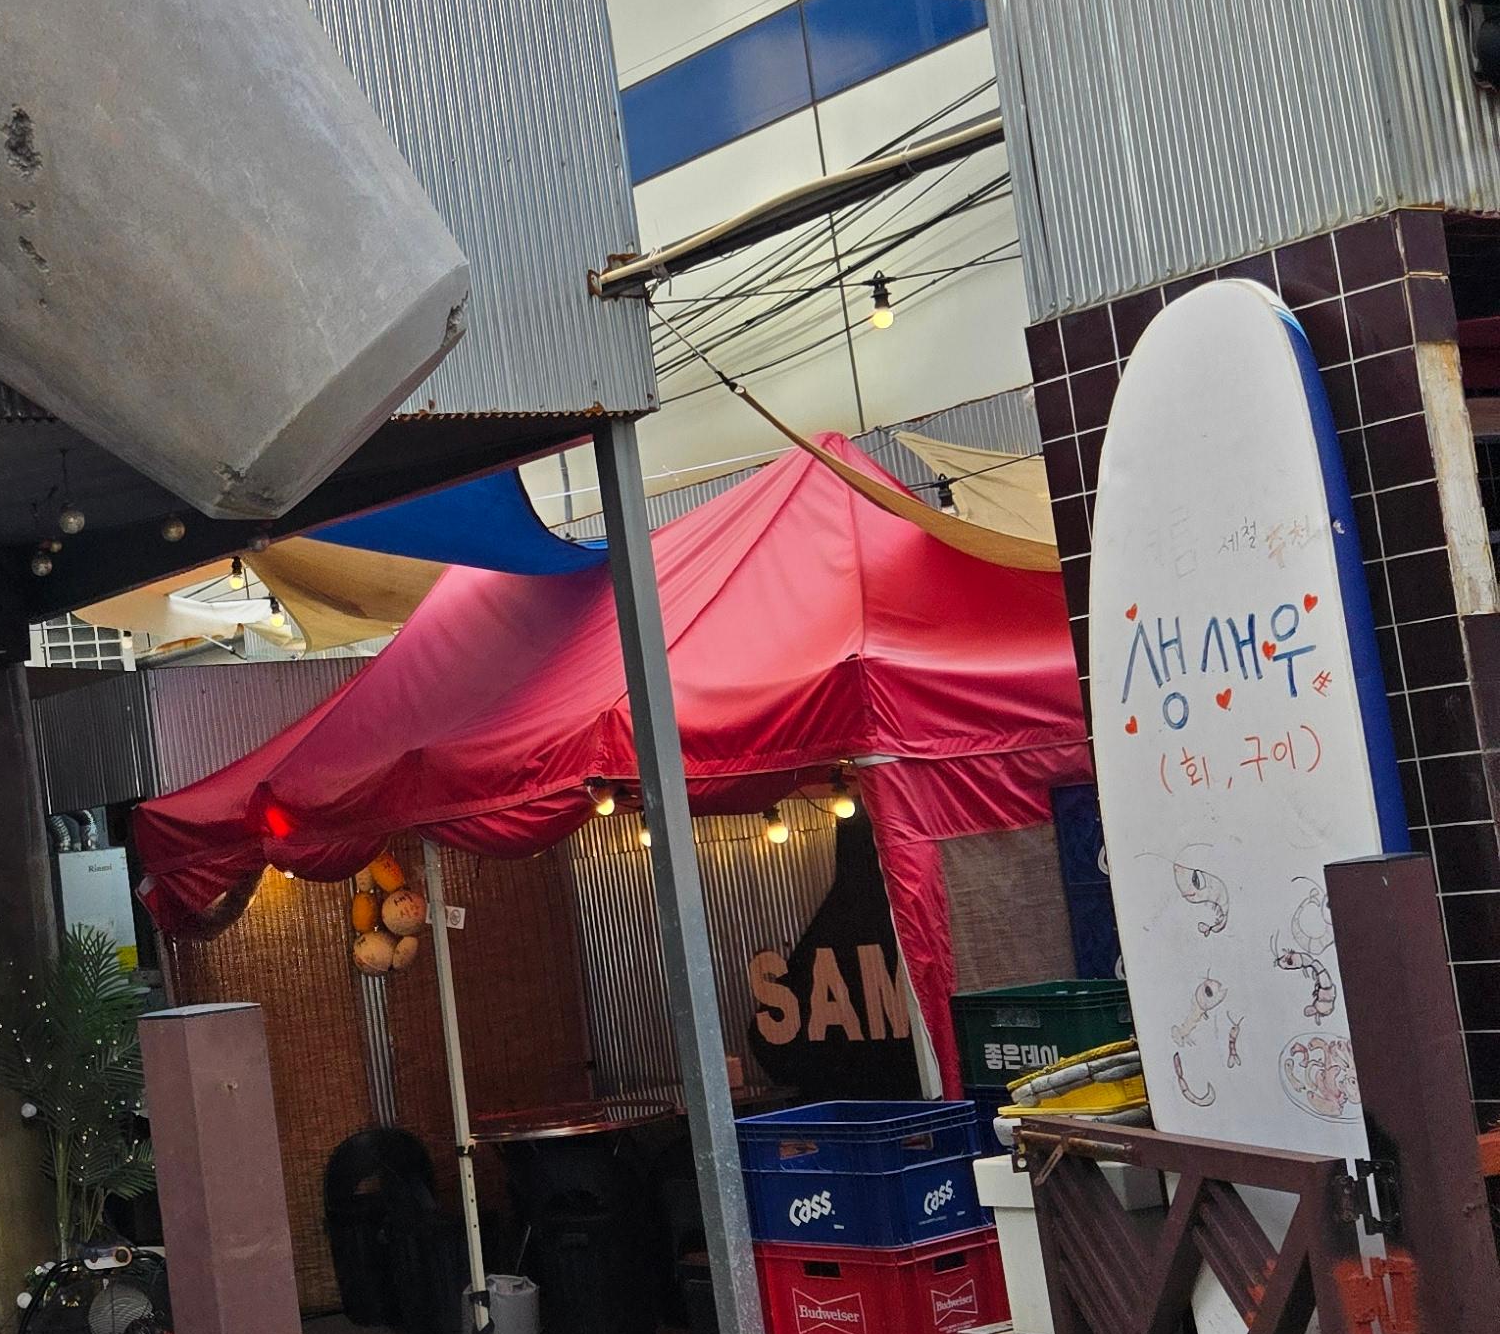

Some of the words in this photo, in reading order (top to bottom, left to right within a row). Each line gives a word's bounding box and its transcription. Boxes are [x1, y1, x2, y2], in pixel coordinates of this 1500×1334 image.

[1121, 603, 1317, 730] 생새우
[984, 1043, 1059, 1070] 좋은데이
[799, 1304, 860, 1323] Budweiser
[936, 1294, 973, 1312] Budweiser
